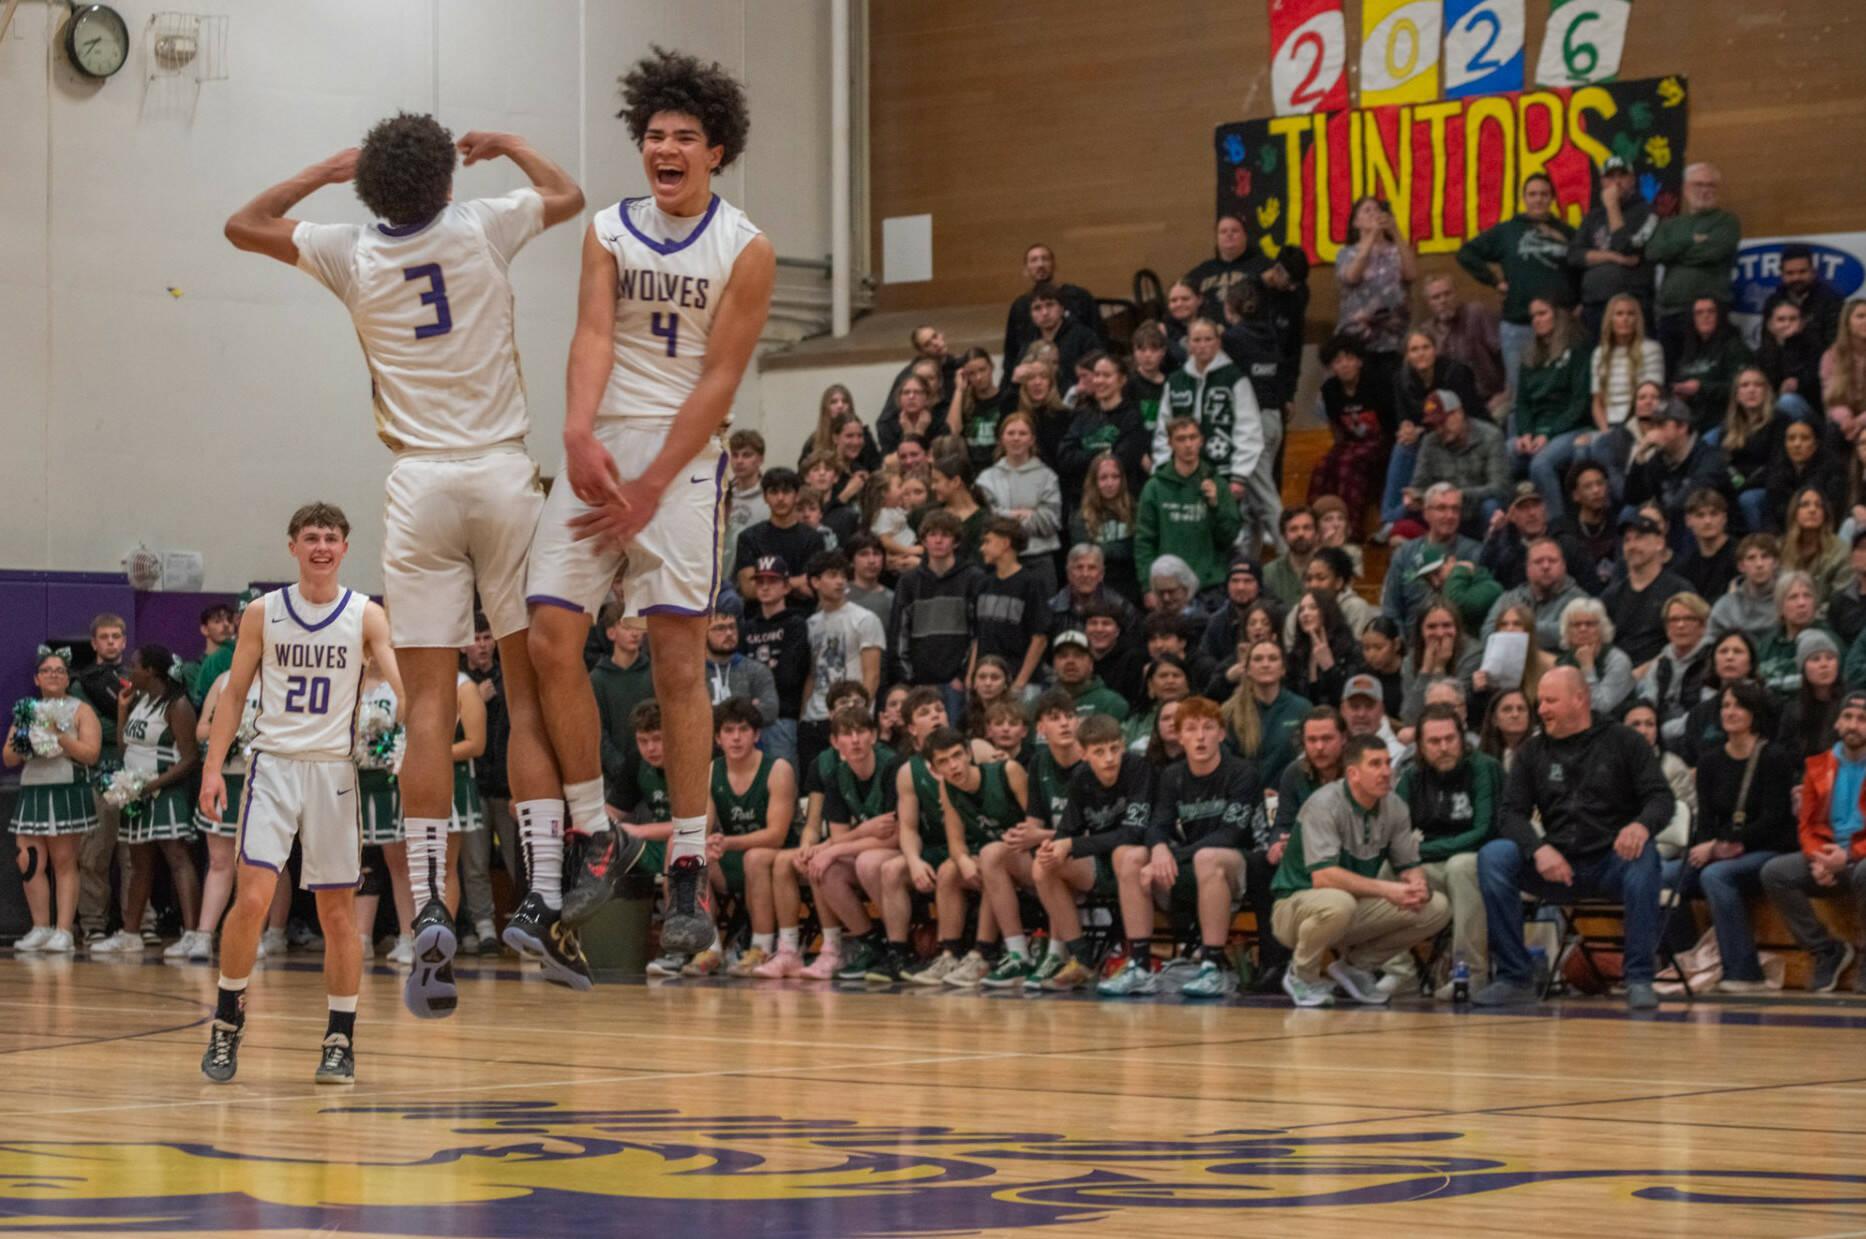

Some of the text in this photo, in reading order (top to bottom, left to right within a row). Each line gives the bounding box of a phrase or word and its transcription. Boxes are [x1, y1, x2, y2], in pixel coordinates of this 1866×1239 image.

[1259, 86, 1618, 263] JUNIORS
[403, 262, 452, 340] 3
[619, 269, 710, 310] WOLVES
[651, 311, 680, 358] 4
[758, 556, 776, 571] W
[275, 643, 347, 669] WOLVES
[285, 675, 331, 715] 20
